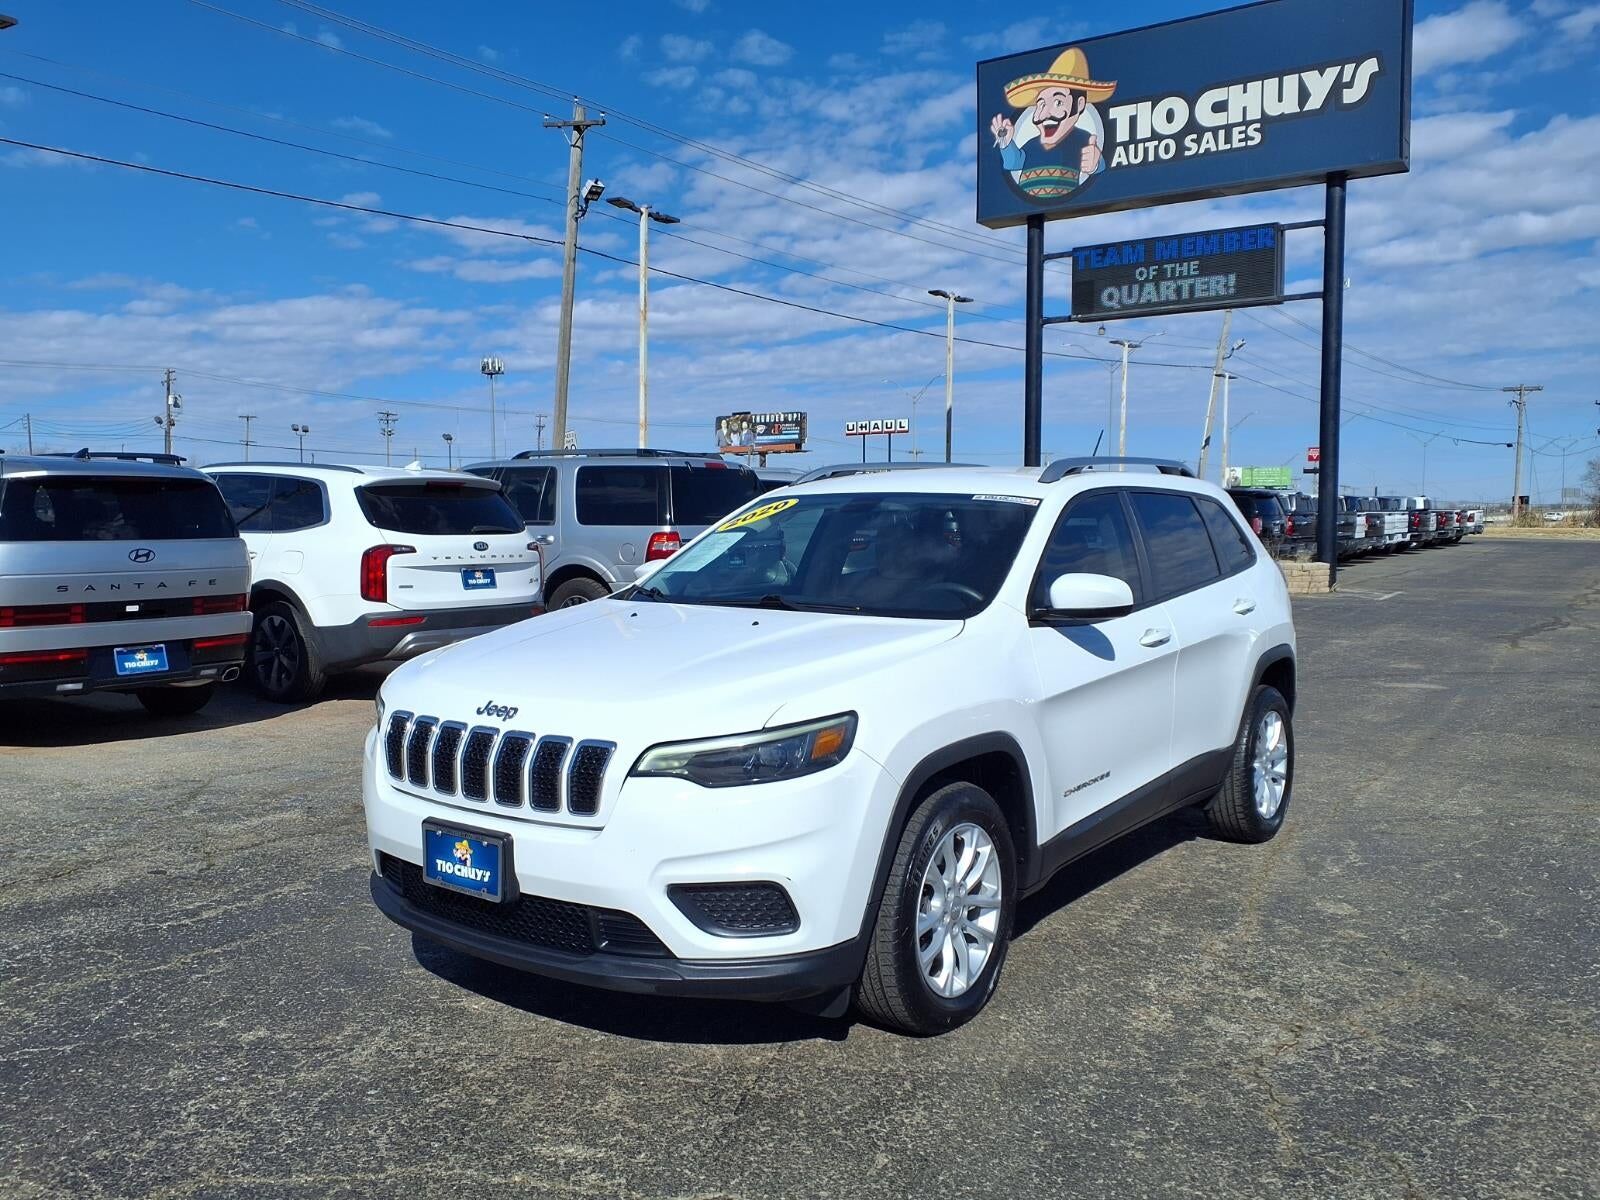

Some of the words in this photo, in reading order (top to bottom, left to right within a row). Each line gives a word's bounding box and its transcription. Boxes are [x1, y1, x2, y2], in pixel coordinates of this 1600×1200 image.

[1109, 97, 1190, 143] TIO
[1194, 58, 1379, 127] CHUY'S
[1111, 138, 1176, 168] AUTO
[1184, 123, 1262, 157] SALES
[1075, 243, 1145, 270] TEAM
[1155, 227, 1275, 260] MEMBER
[1135, 265, 1158, 281] OF
[1164, 261, 1200, 278] THE
[1101, 272, 1236, 309] QUARTER!
[724, 501, 790, 529] 2020
[56, 582, 167, 592] SANTA
[188, 579, 217, 587] FE
[476, 700, 518, 721] Jeep
[436, 859, 453, 874] TIO
[454, 864, 490, 882] CHUY'S
